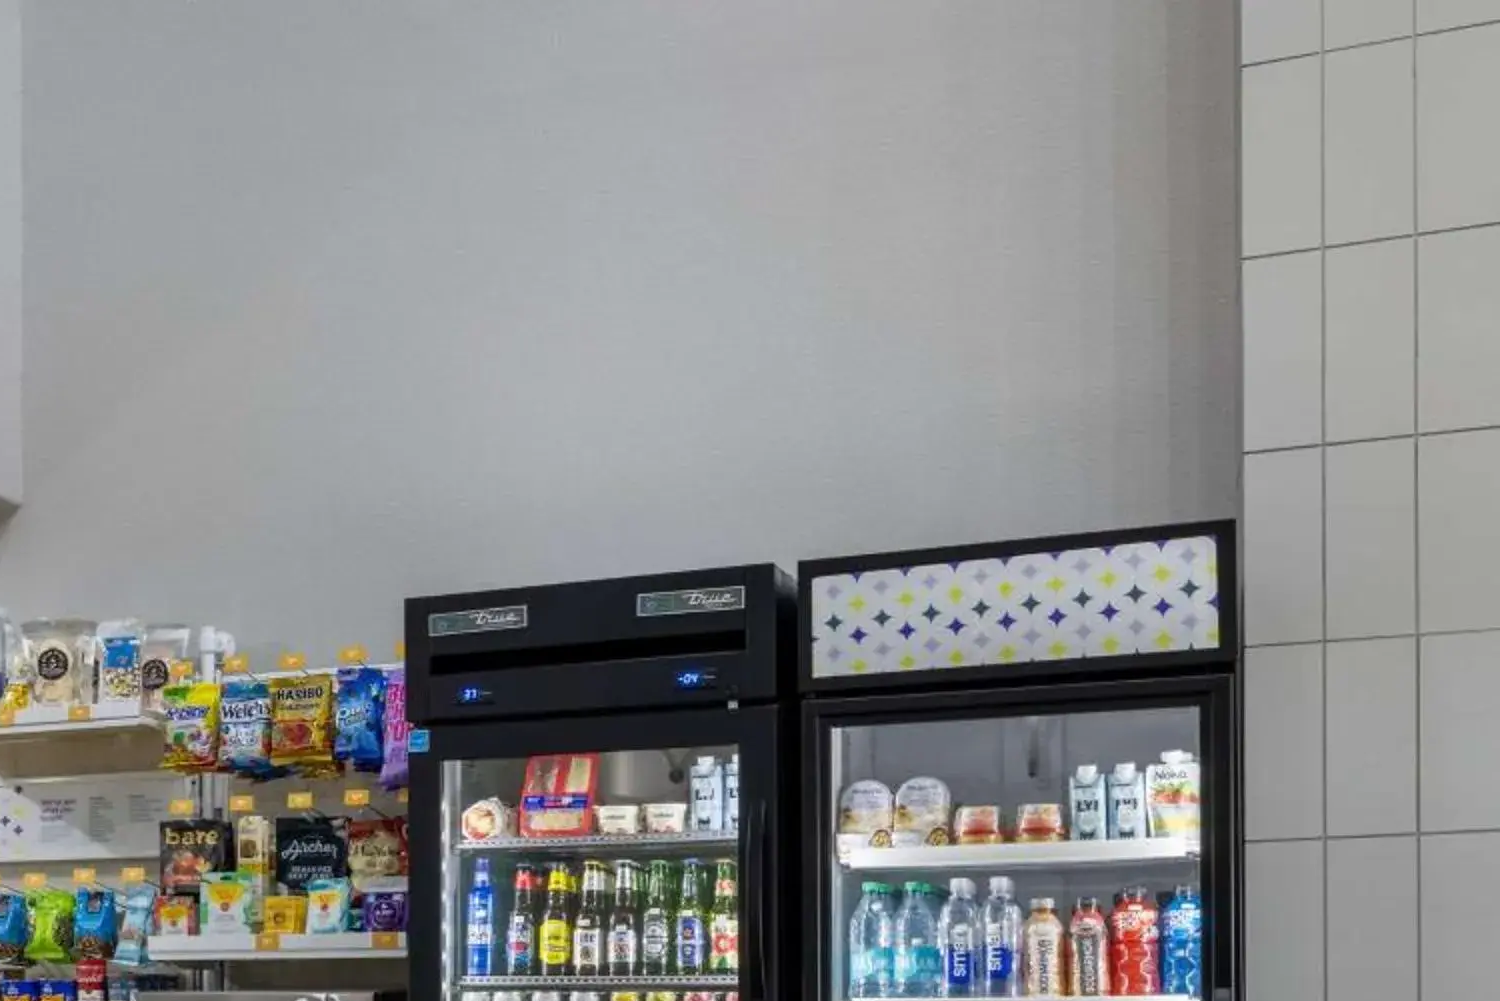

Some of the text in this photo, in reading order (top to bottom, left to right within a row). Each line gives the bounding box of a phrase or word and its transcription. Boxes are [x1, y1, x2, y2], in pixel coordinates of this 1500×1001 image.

[276, 686, 323, 701] HARIBO
[165, 828, 219, 846] bare
[281, 839, 338, 860] Archer
